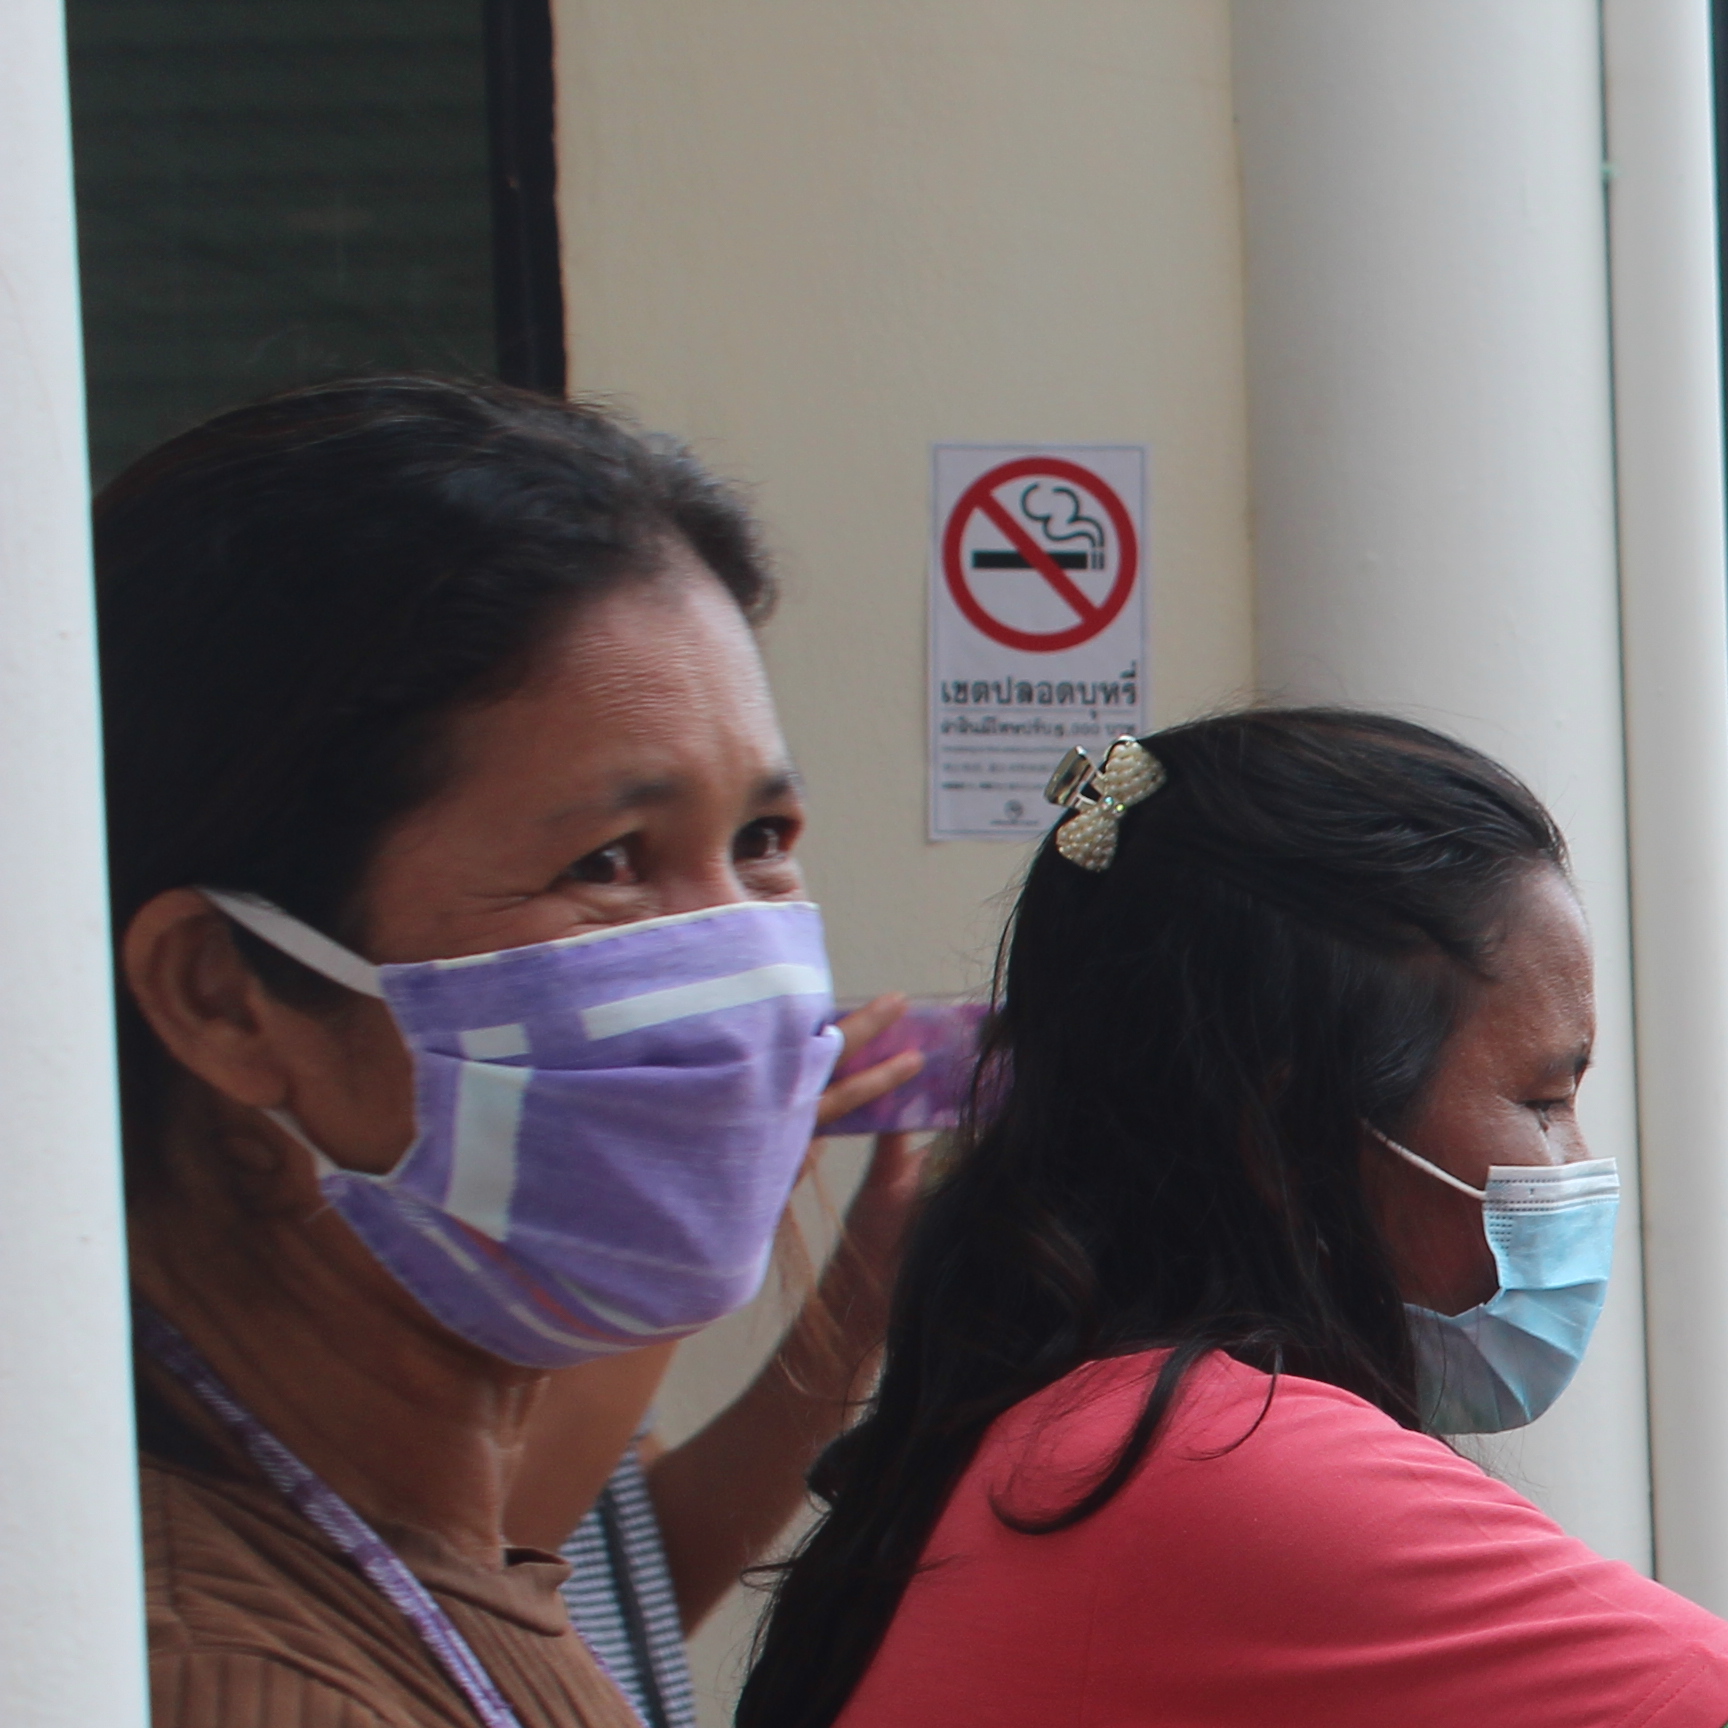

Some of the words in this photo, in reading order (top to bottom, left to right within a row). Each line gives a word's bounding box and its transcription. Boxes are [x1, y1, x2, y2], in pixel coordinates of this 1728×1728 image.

[940, 660, 1137, 720] เขตปลอดบุหรี่
